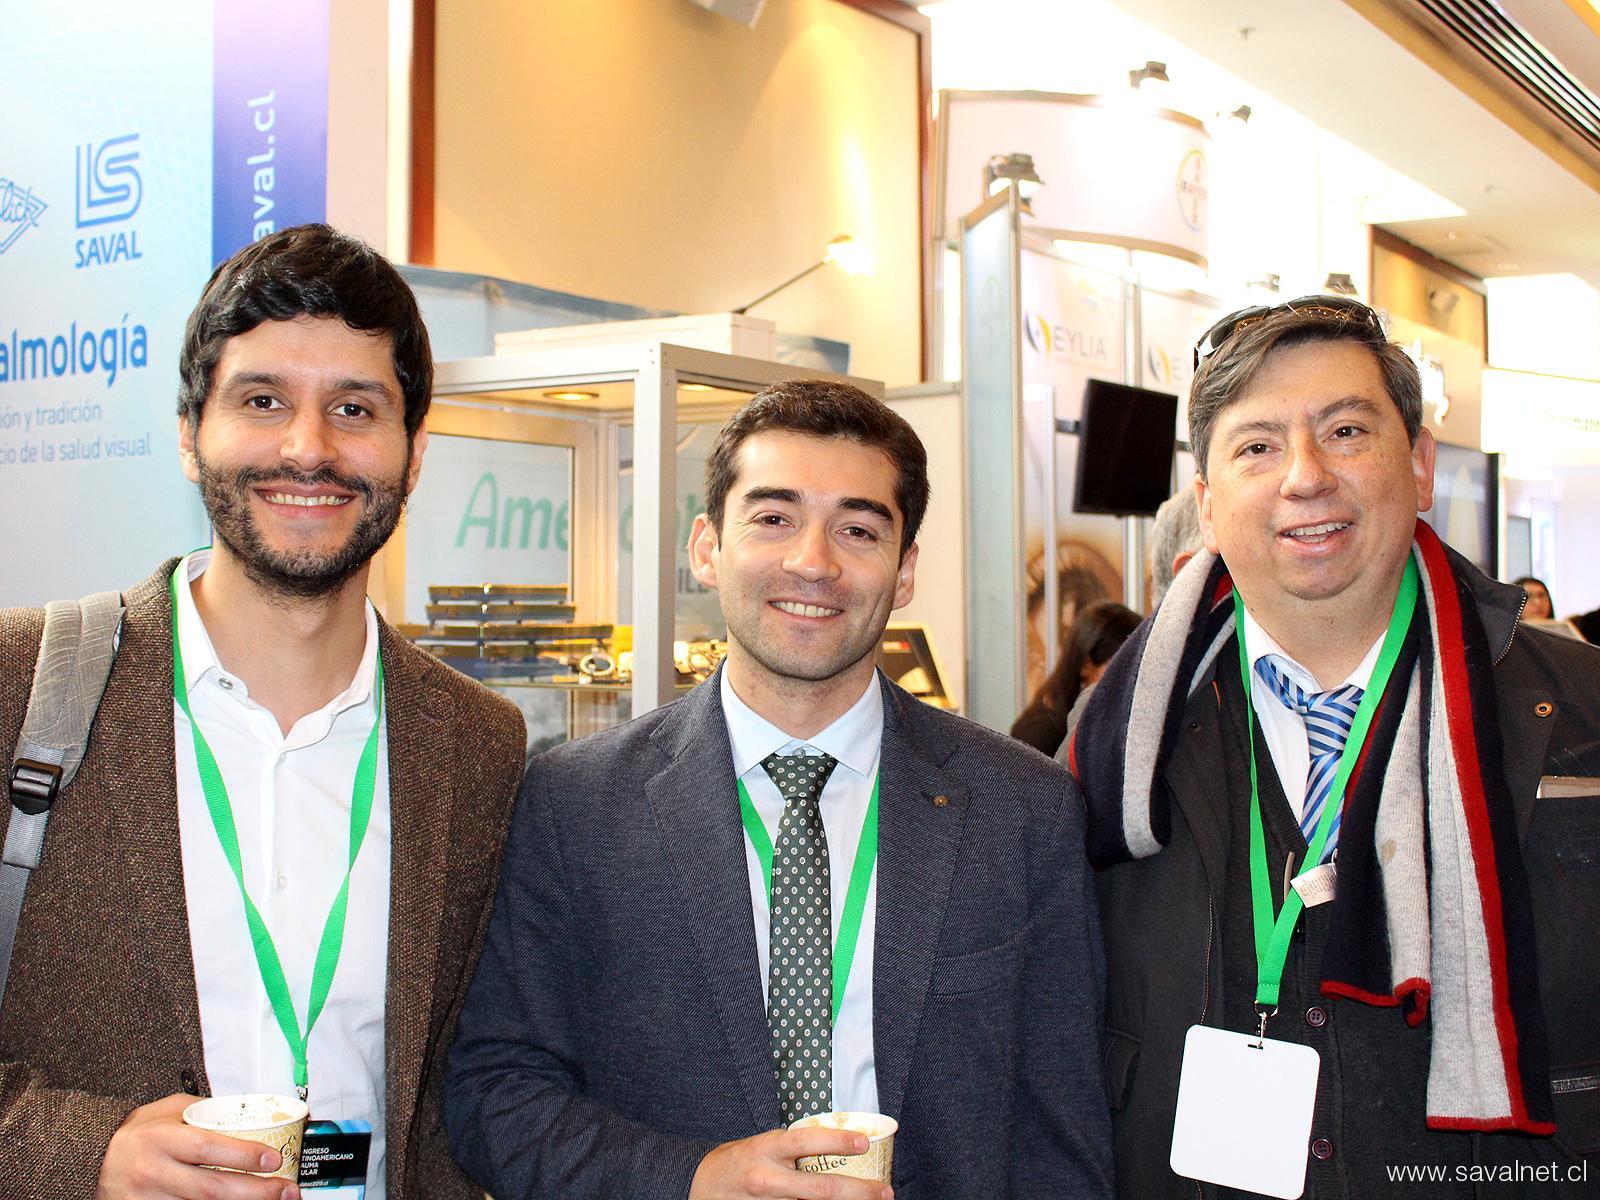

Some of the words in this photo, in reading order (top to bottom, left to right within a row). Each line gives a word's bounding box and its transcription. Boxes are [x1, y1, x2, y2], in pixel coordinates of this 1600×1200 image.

[75, 230, 142, 269] SAVAL
[0, 311, 148, 389] almología
[1052, 325, 1107, 361] EYLIA
[23, 410, 33, 433] y
[36, 398, 102, 426] tradición
[19, 442, 37, 464] de
[41, 439, 55, 463] la
[59, 436, 101, 462] salud
[104, 431, 152, 458] visual
[301, 1153, 354, 1162] TINOAMERICANO
[302, 1147, 330, 1155] NGRESO
[804, 1154, 848, 1174] coffee
